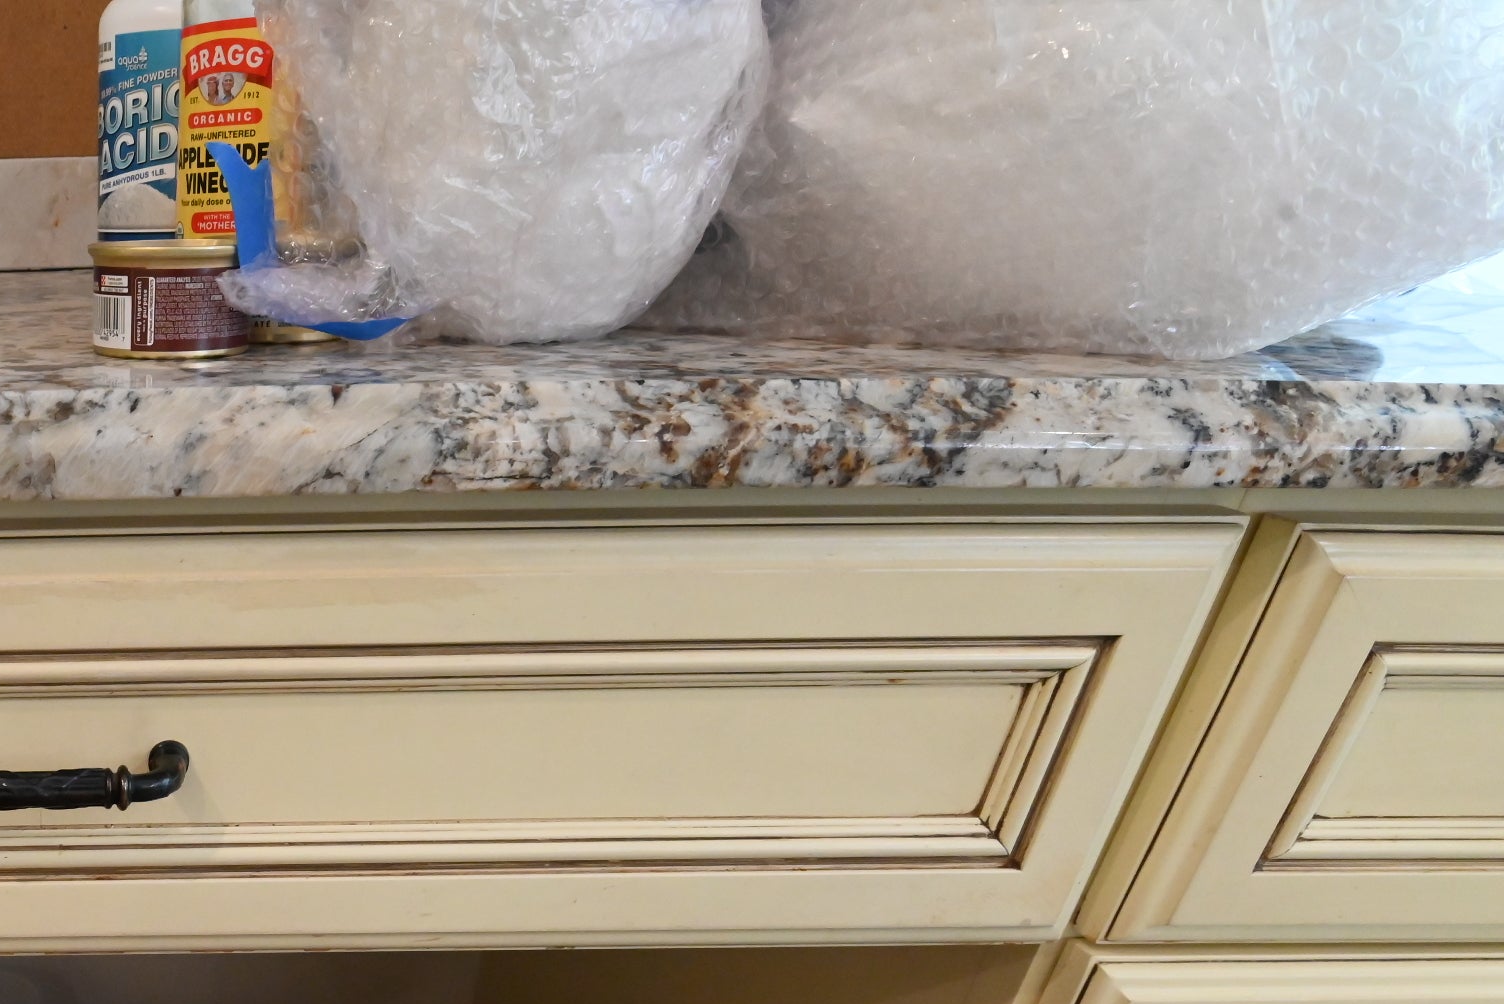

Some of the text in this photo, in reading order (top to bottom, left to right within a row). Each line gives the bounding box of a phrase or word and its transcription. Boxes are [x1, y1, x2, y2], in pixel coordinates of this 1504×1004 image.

[118, 56, 138, 67] aqua
[190, 44, 264, 75] BRAGG
[118, 78, 134, 91] FINE
[137, 68, 177, 85] POWDER
[194, 112, 252, 125] ORGANIC
[191, 129, 255, 141] RAW-UNFILTERED
[100, 122, 178, 176] ACID
[113, 171, 149, 187] ANHYDROUS
[191, 199, 204, 207] daily
[207, 198, 223, 206] dose
